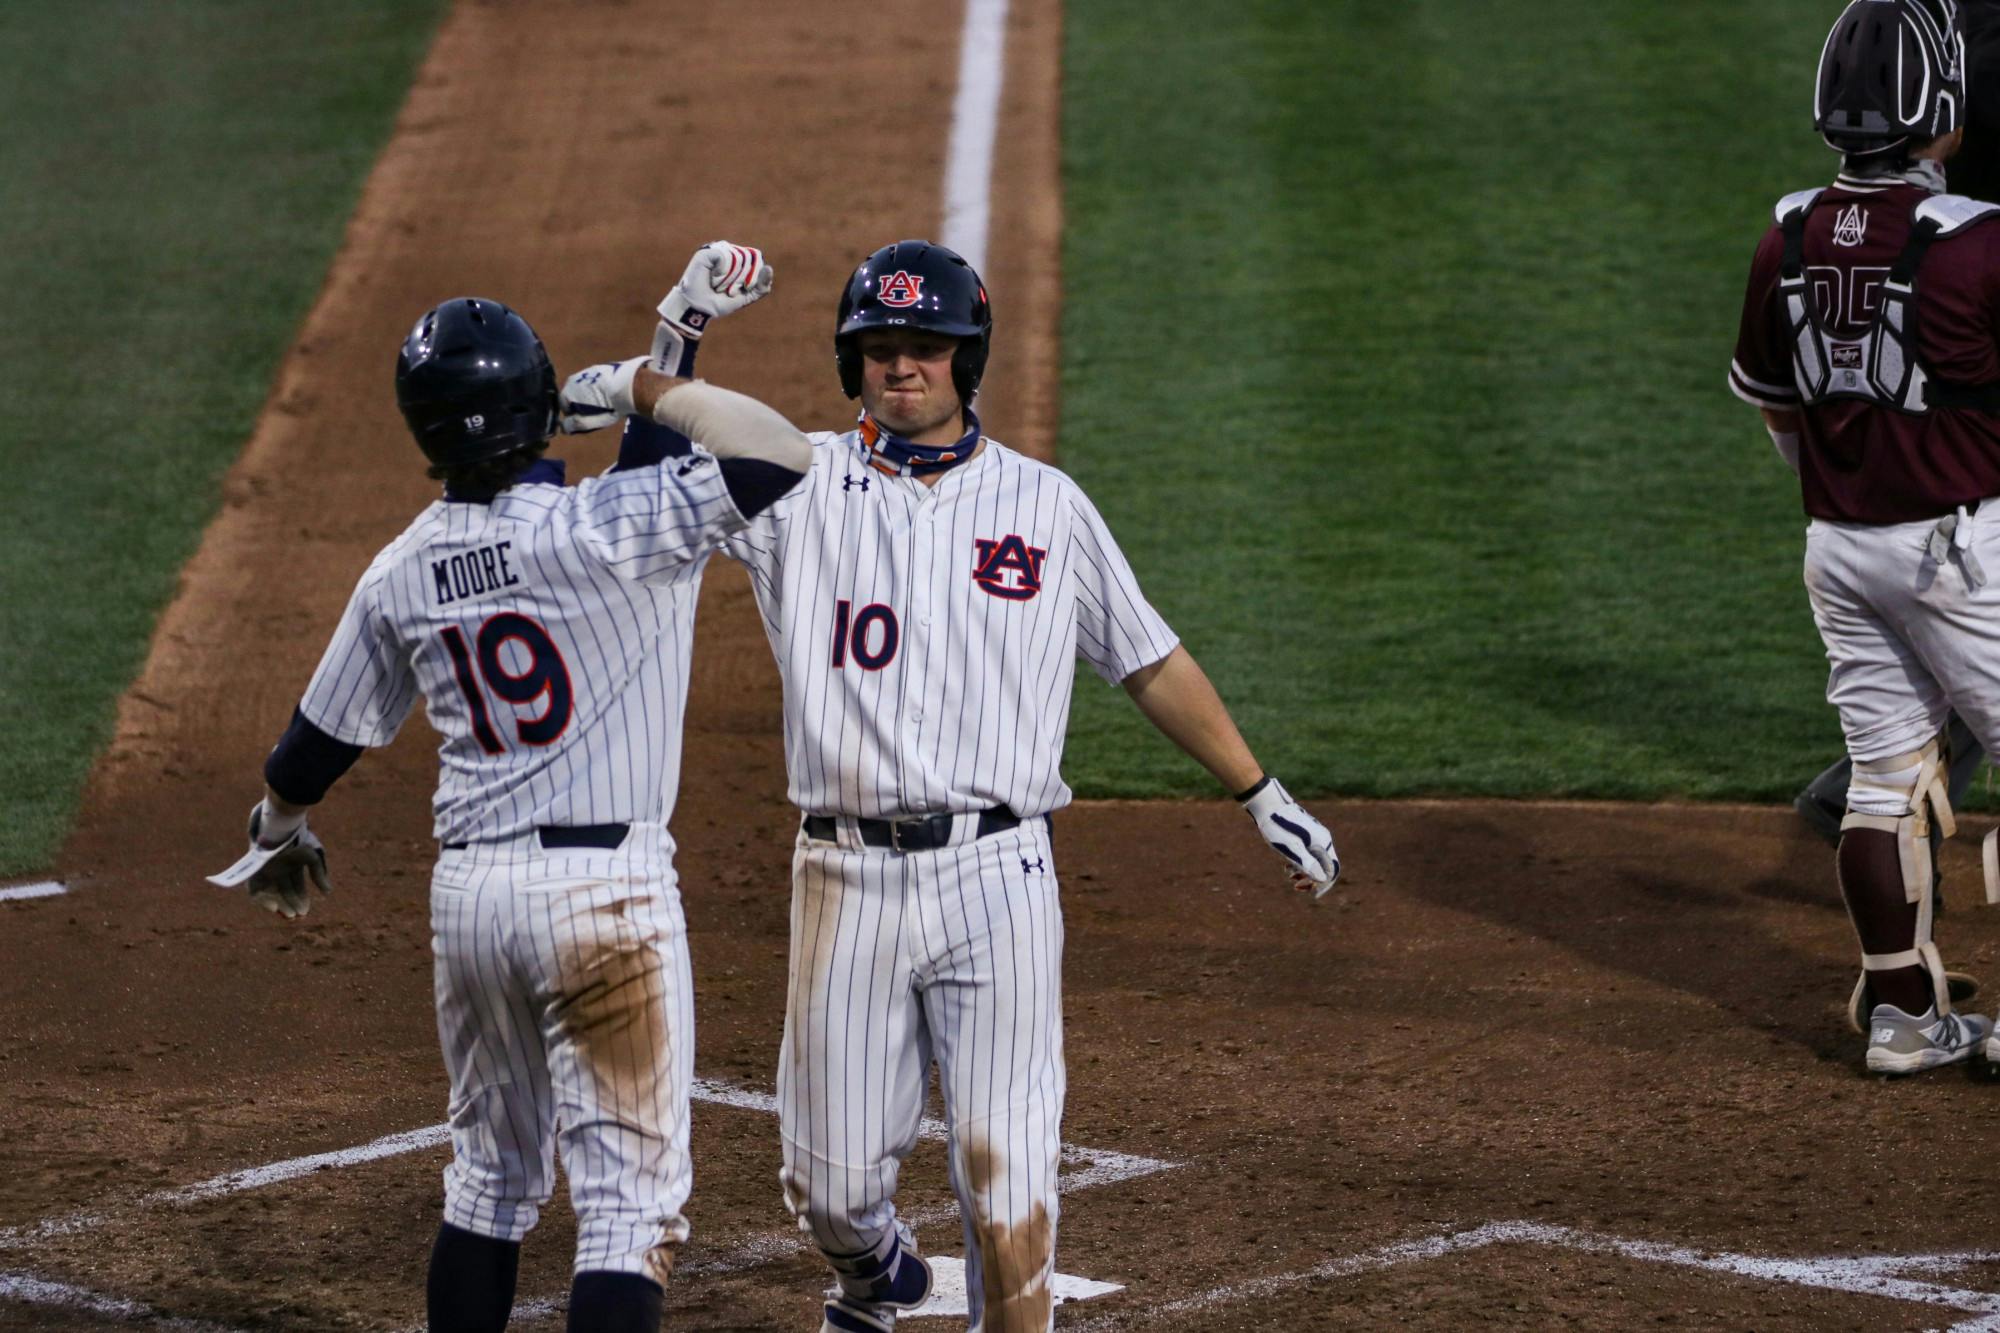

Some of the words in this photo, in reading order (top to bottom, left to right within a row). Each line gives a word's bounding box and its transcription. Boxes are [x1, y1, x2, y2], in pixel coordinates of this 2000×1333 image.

[464, 414, 484, 428] 19
[431, 540, 519, 605] MOORE
[832, 599, 899, 671] 10
[439, 611, 574, 756] 19
